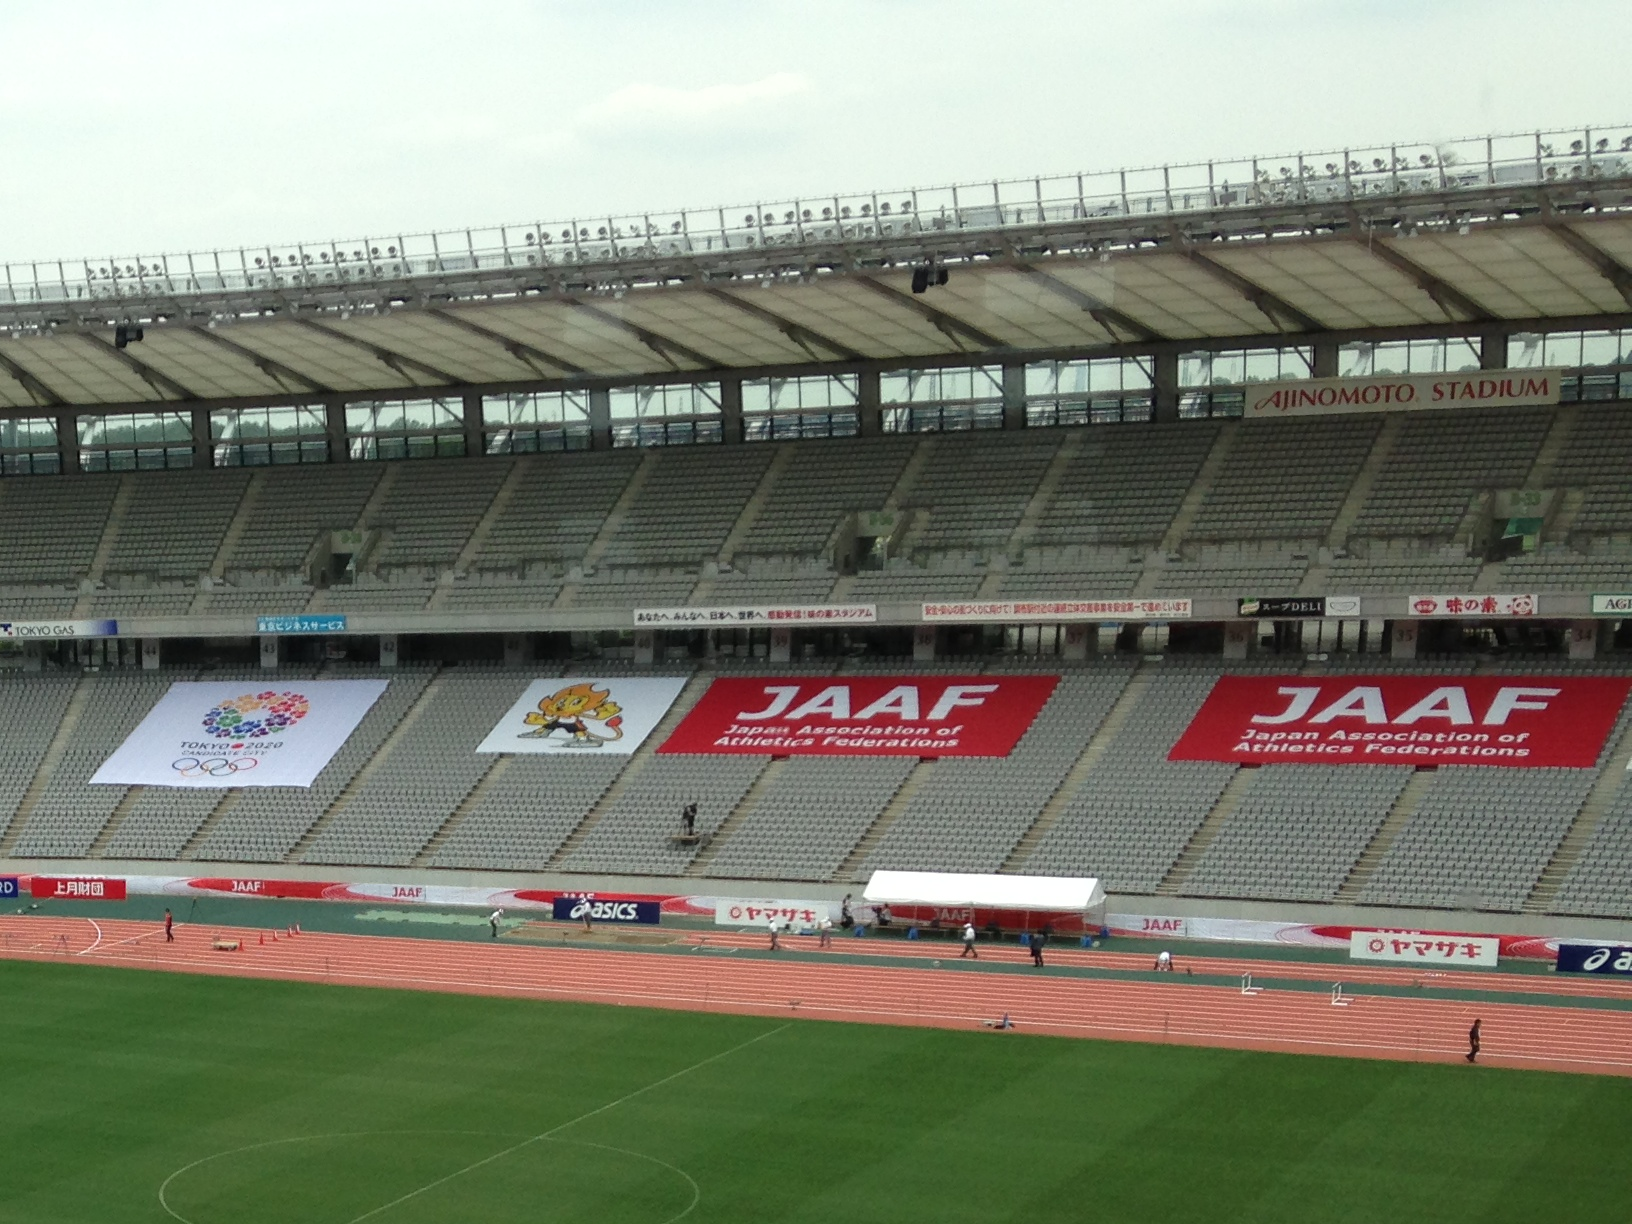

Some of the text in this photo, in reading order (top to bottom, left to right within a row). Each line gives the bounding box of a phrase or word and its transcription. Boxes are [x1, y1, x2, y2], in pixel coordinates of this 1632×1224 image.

[1254, 378, 1549, 411] AJINOMOTO STADIUM
[1446, 597, 1499, 614] 味の素
[16, 625, 50, 636] TOKYO
[53, 625, 74, 636] GAS
[263, 643, 275, 653] 43
[383, 641, 394, 652] 42
[736, 684, 999, 721] JAAF
[1251, 686, 1562, 726] JAAF
[724, 724, 963, 737] Japan Association of
[1240, 729, 1530, 744] Japan Association of
[181, 741, 284, 749] TOKYO 2020
[714, 736, 960, 748] Athletics Federations
[1232, 742, 1530, 757] Athletics Federations
[53, 881, 105, 896] 上月財団
[231, 880, 261, 893] JAAF
[391, 886, 423, 898] JAAF
[591, 901, 639, 920] asics
[1142, 918, 1182, 931] JAAF
